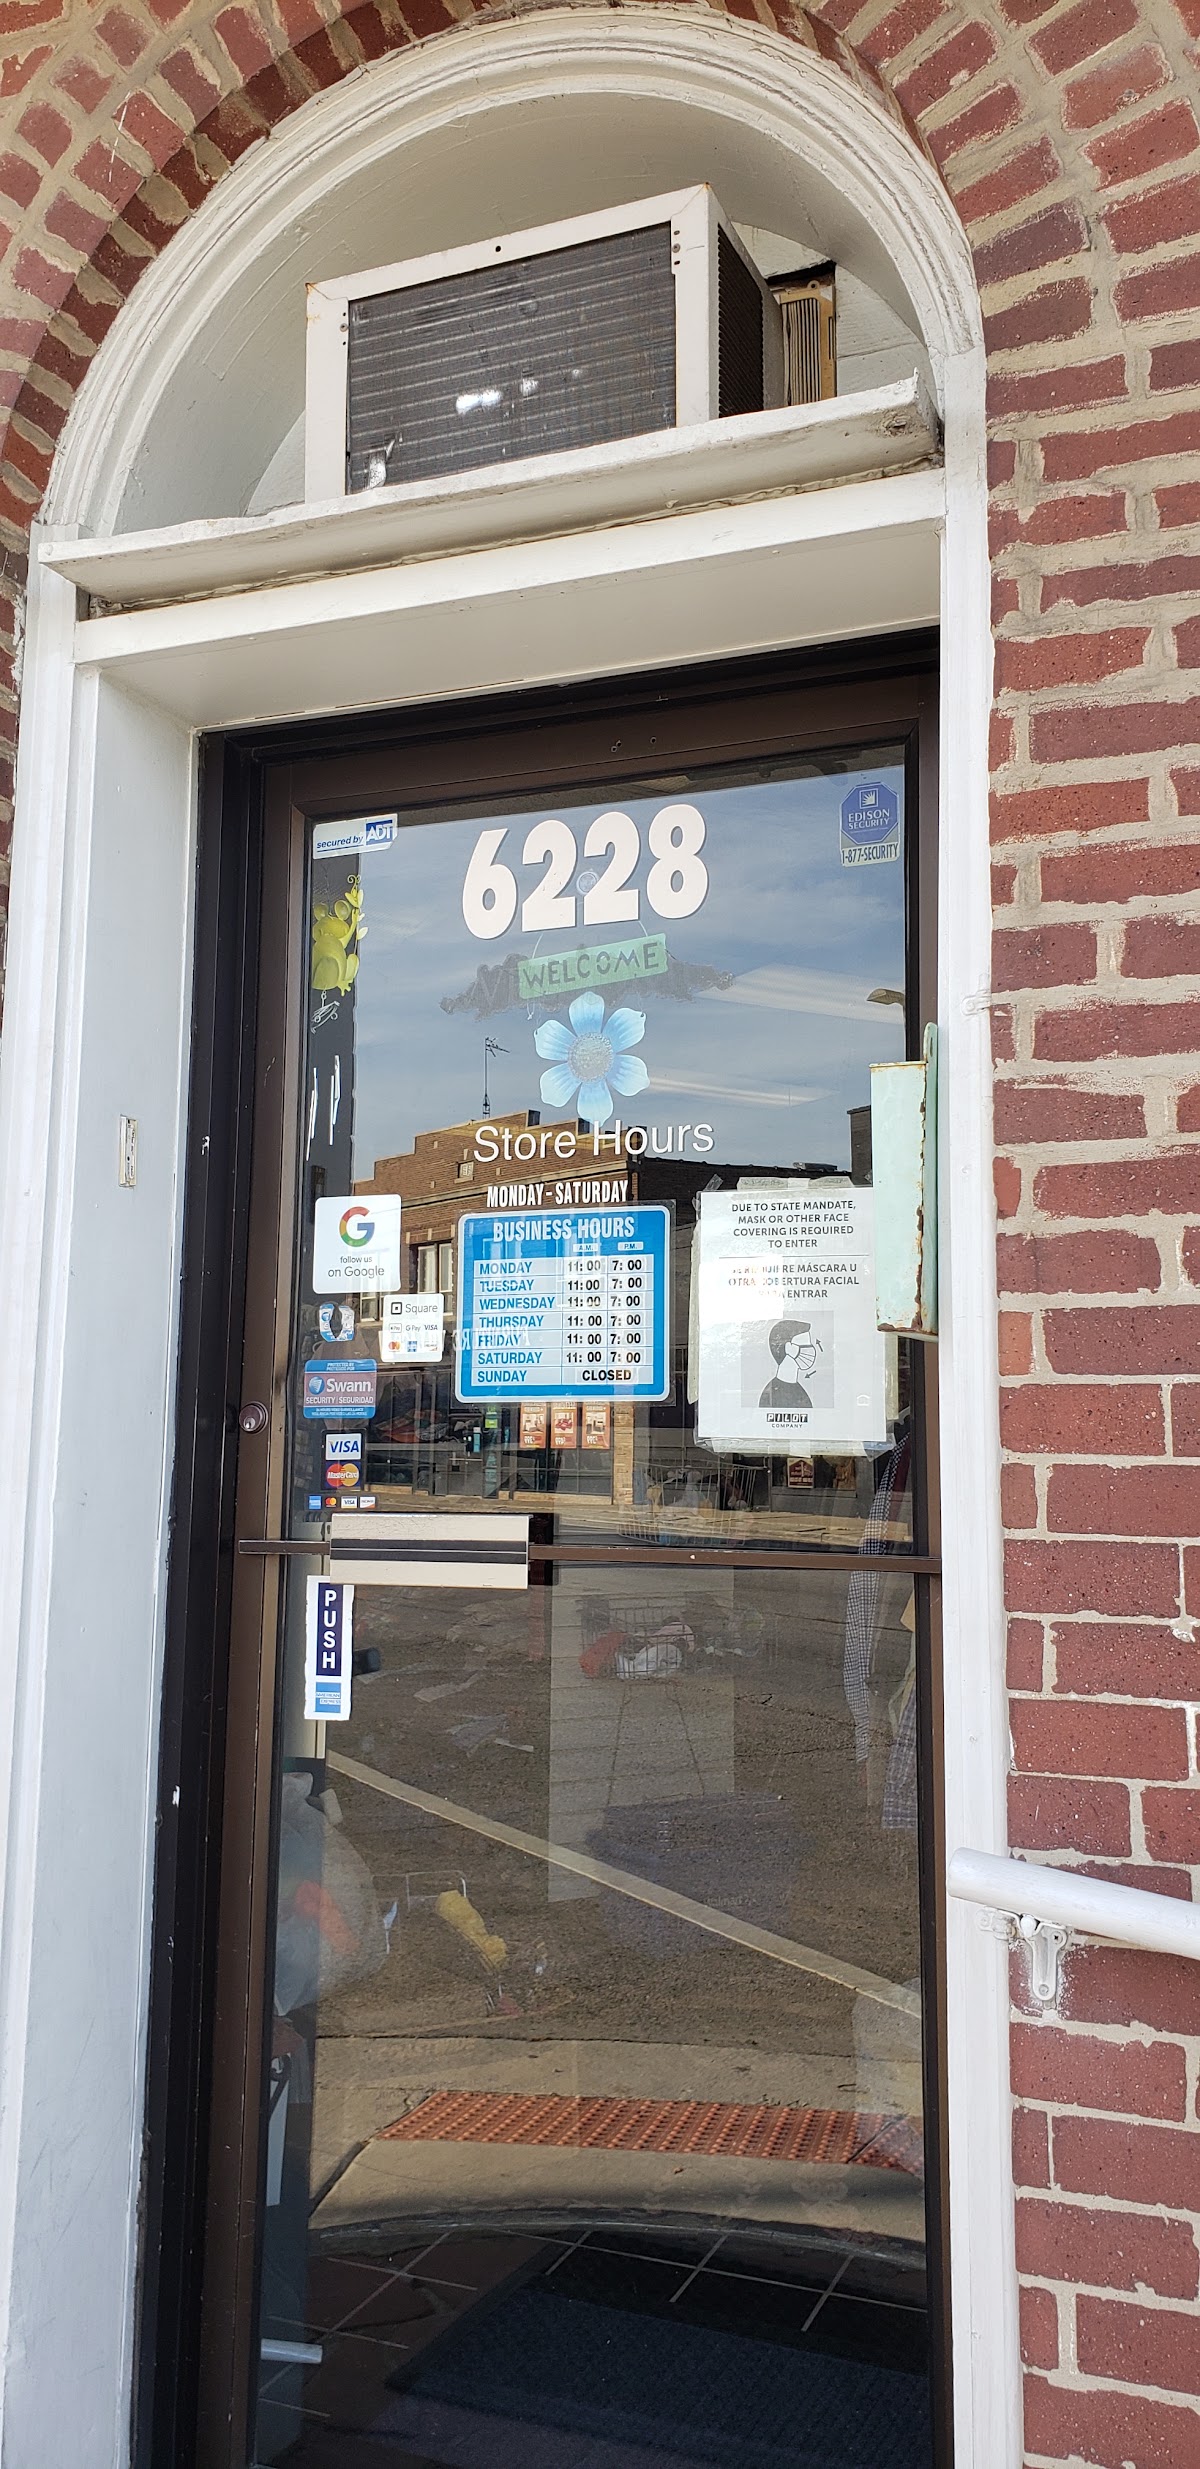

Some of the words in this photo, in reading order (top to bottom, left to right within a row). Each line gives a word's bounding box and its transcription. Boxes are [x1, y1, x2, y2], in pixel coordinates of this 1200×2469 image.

[848, 808, 890, 823] EDISON
[848, 817, 890, 830] SECURITY
[316, 837, 352, 850] secured
[352, 834, 364, 847] by
[365, 822, 394, 844] ADT
[841, 843, 899, 865] 1-877-SECURITY
[462, 803, 709, 940] 6228
[522, 942, 660, 989] WELCOME
[473, 1124, 577, 1162] Store
[592, 1118, 714, 1157] Hours
[731, 1203, 752, 1212] DUE
[754, 1203, 768, 1212] TO
[770, 1202, 801, 1211] STATE
[803, 1200, 857, 1210] MANDATE,
[738, 1215, 767, 1225] MASK
[768, 1215, 784, 1224] OR
[785, 1214, 821, 1223] OTHER
[823, 1213, 849, 1222] FACE
[492, 1218, 572, 1242] BUSINESS
[577, 1216, 635, 1239] HOURS
[733, 1227, 787, 1237] COVERING
[789, 1227, 798, 1235] IS
[800, 1226, 854, 1235] REQUIRED
[578, 1244, 594, 1252] A.M.
[623, 1242, 638, 1250] P.M.
[767, 1239, 783, 1248] TO
[785, 1239, 818, 1248] ENTER
[340, 1255, 363, 1264] follow
[363, 1255, 373, 1264] us
[327, 1268, 342, 1278] on
[344, 1265, 385, 1279] Google
[479, 1261, 533, 1275] MONDAY
[797, 1262, 847, 1273] MÁSCARA
[849, 1263, 857, 1272] U
[479, 1279, 535, 1293] TUESDAY
[823, 1276, 860, 1285] FACIAL
[787, 1289, 828, 1298] ENTRAR
[405, 1304, 438, 1315] Square
[479, 1296, 556, 1310] WEDNESDAY
[411, 1324, 421, 1332] Pay
[479, 1315, 544, 1328] THURSDAY
[478, 1333, 523, 1347] FRIDAY
[477, 1351, 543, 1365] SATURDAY
[477, 1370, 528, 1383] SUNDAY
[582, 1369, 632, 1382] CLOSED
[326, 1378, 371, 1393] Swann
[305, 1396, 336, 1404] SECURITY
[338, 1396, 374, 1404] SEGURIDAD
[767, 1413, 808, 1423] PILOT
[328, 1440, 360, 1453] VISA
[321, 1589, 337, 1669] PUSH
